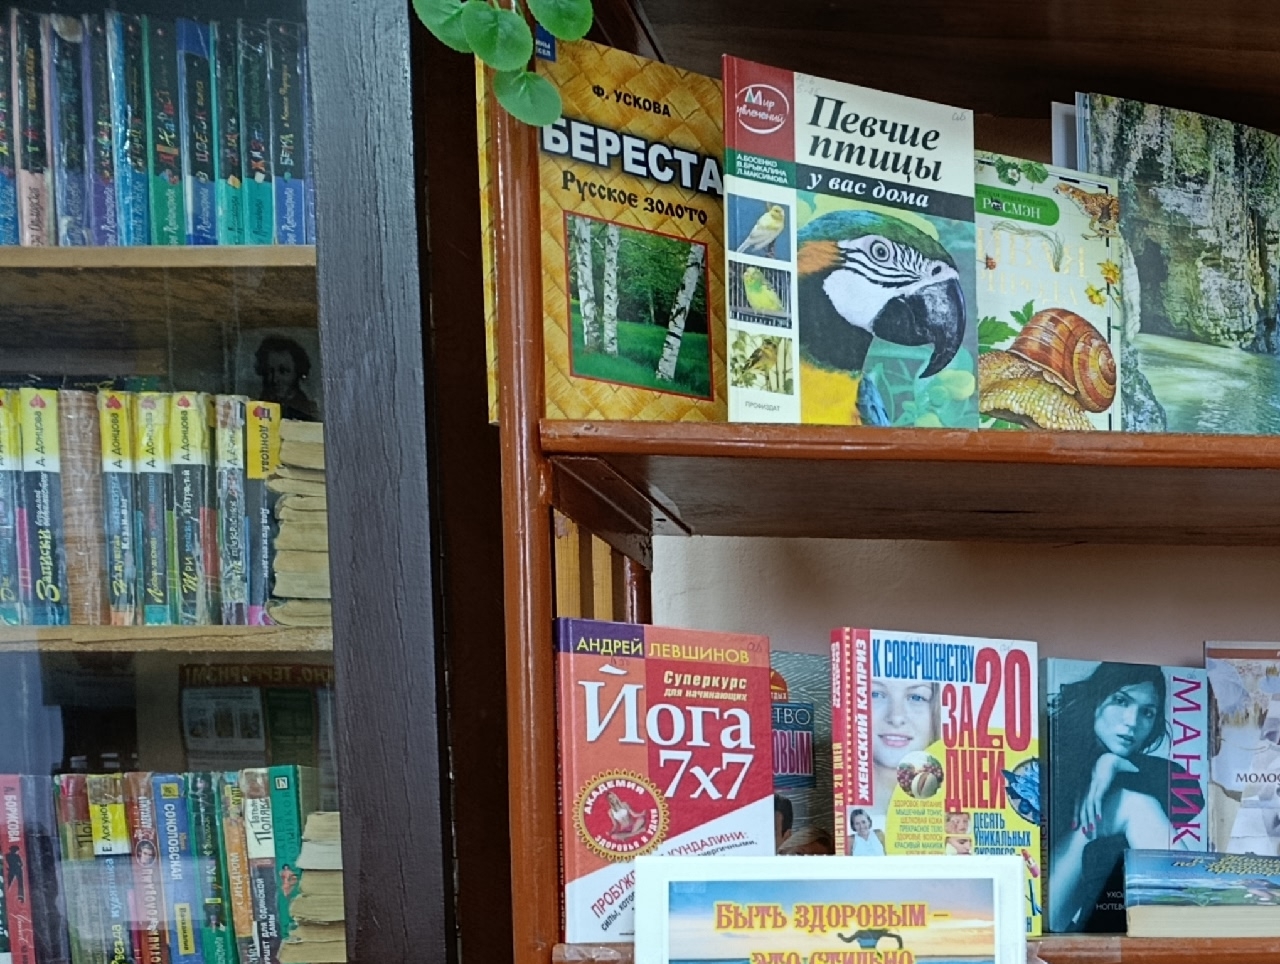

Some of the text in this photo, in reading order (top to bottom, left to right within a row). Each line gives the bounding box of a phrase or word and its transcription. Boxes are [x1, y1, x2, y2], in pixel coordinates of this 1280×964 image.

[592, 84, 671, 117] Ф. УСКОВА
[744, 87, 775, 110] Мир
[806, 94, 940, 150] Певчие
[541, 117, 723, 195] БЕРЕСТА
[808, 134, 942, 183] птицы
[561, 170, 638, 208] Русское
[807, 172, 930, 208] у вас дома
[577, 636, 750, 665] АНДРЕЙ ЛЕВШИНОВ
[873, 639, 975, 683] К СОВЕРШЕНСТВУ
[663, 671, 747, 691] Суперкурс
[664, 688, 748, 702] для начинающих
[941, 647, 1032, 752] ЗА 20
[577, 664, 755, 749] Йога
[854, 638, 869, 801] ЖЕНСКИЙ КАПРИЗ
[1172, 676, 1202, 844] МАНИК
[584, 778, 645, 816] АКАДЕМИЯ
[163, 803, 182, 881] СОКОЛОВСКАЯ
[594, 833, 640, 852] ЗДОРОВЬЯ
[974, 830, 1031, 847] УНИКАЛЬНЫХ
[716, 903, 926, 932] БЫТЬ ЗДОРОВЫМ
